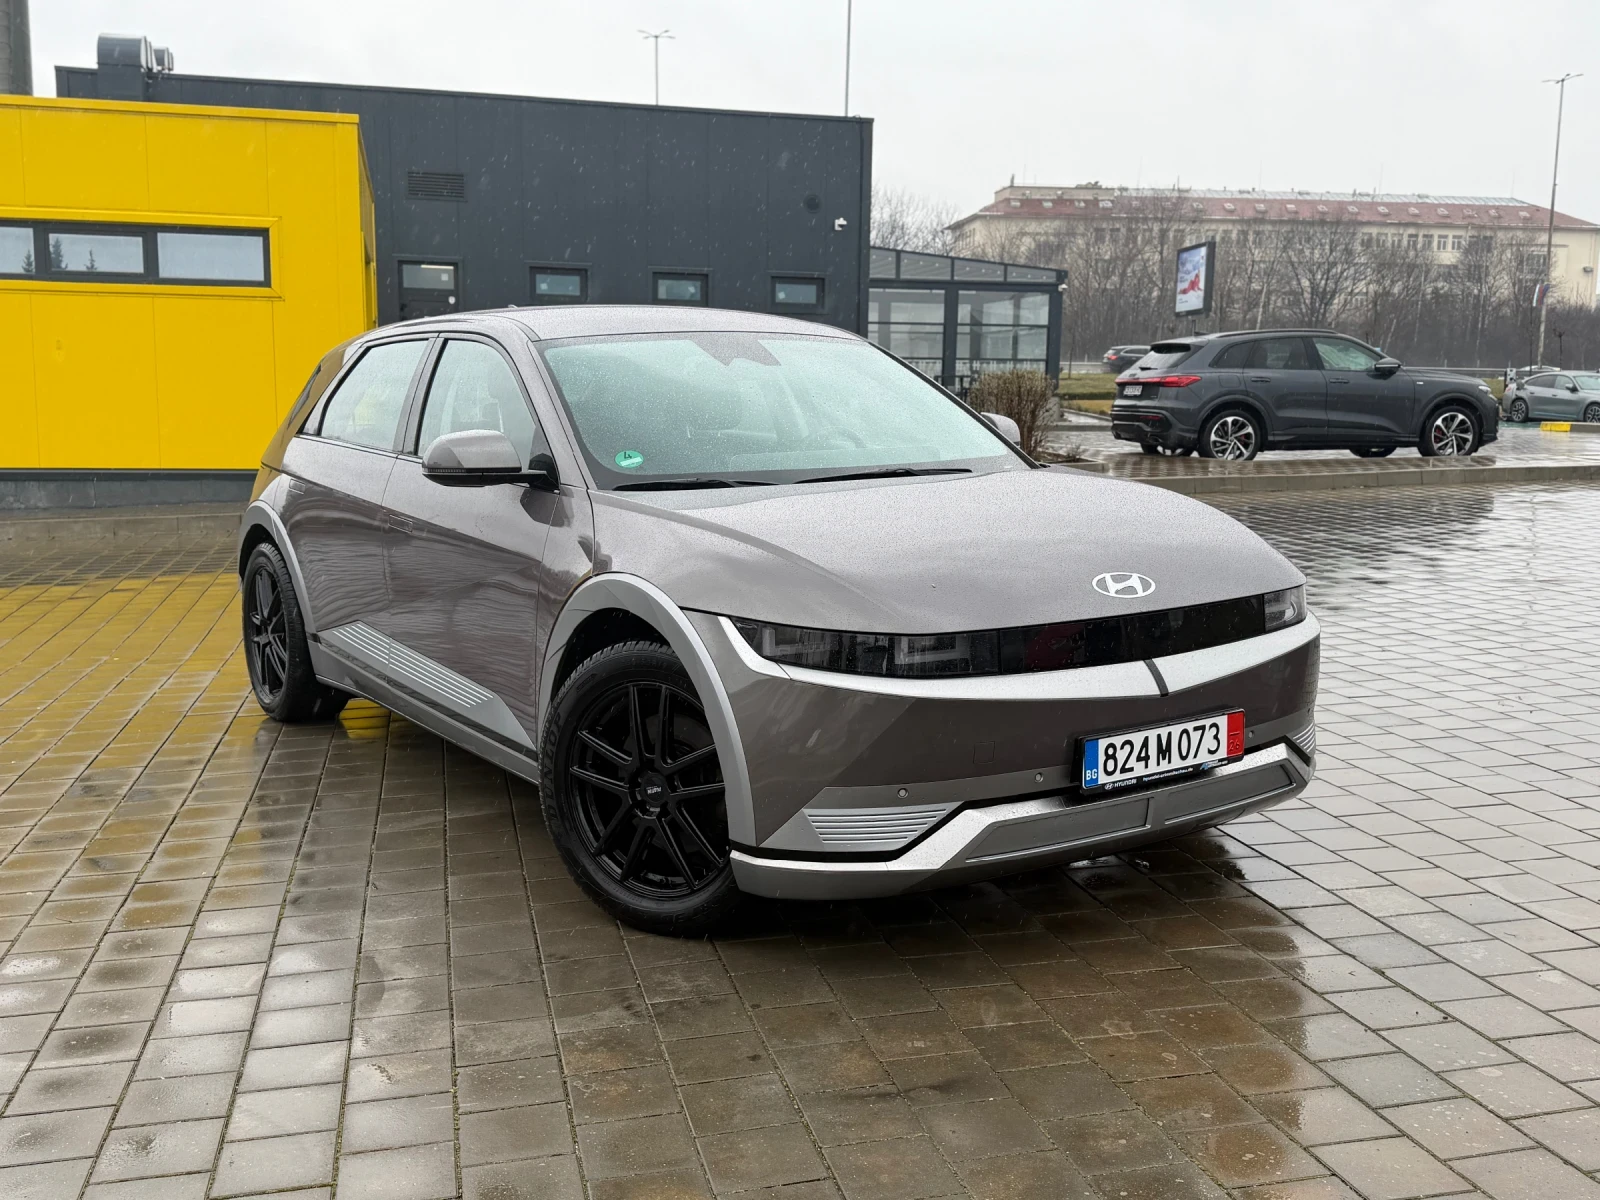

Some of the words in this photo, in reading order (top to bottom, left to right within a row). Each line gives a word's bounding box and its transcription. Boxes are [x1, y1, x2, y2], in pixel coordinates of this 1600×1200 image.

[623, 451, 632, 459] 4
[1103, 735, 1151, 776] 824
[1156, 731, 1172, 767] M
[1177, 722, 1220, 761] 073
[1229, 739, 1240, 752] 26
[544, 711, 562, 820] DUNLOP
[1086, 768, 1098, 781] BG
[1114, 778, 1137, 788] HYUNDAI
